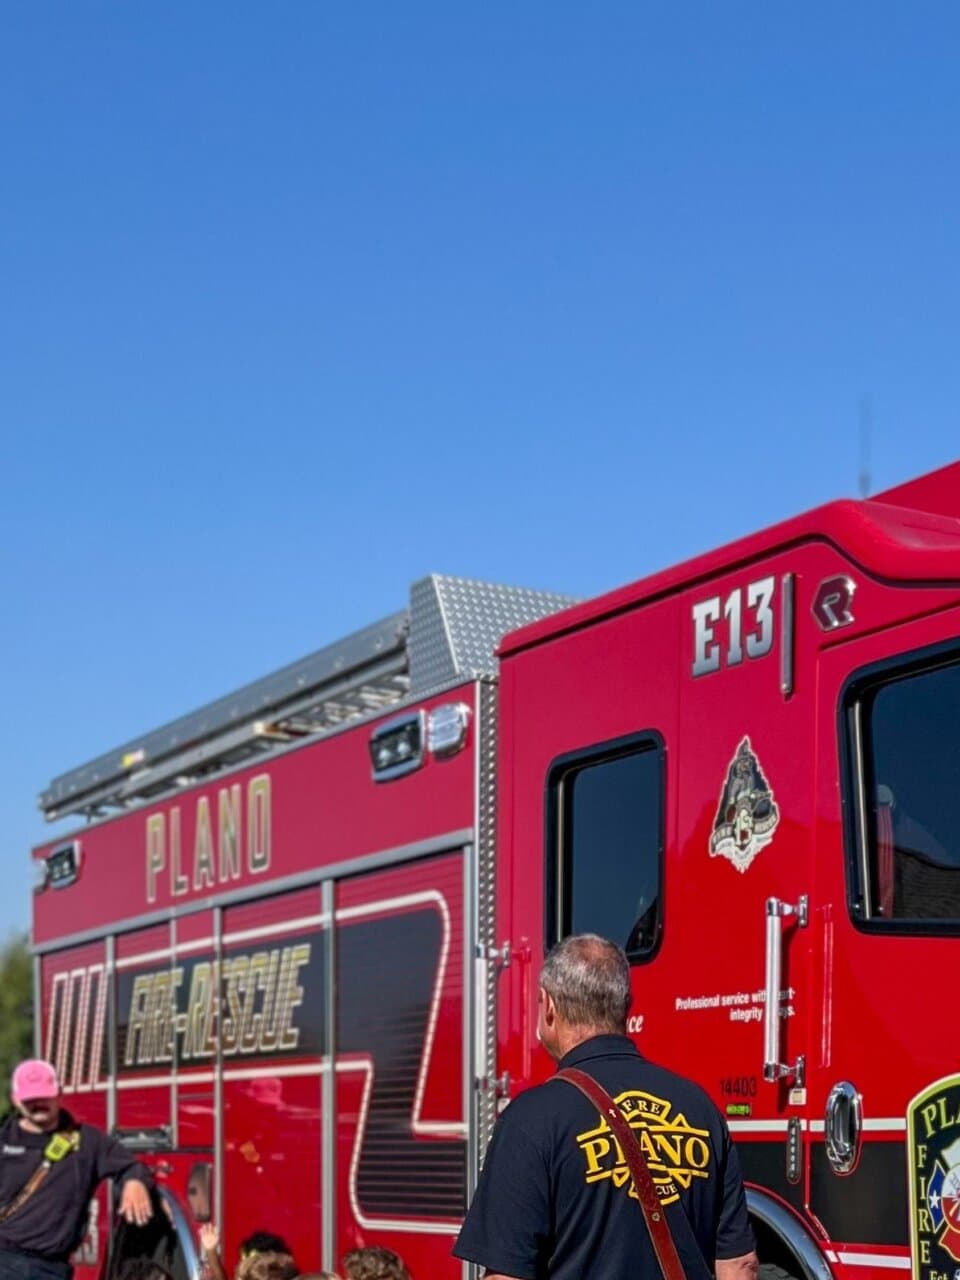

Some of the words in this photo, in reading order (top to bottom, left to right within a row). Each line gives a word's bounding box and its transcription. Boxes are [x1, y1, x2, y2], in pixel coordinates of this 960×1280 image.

[691, 576, 775, 679] E13
[146, 773, 270, 903] PLANO
[675, 994, 720, 1011] Professional
[721, 992, 750, 1006] service
[729, 1006, 763, 1023] integrity
[917, 1144, 932, 1264] FIRE
